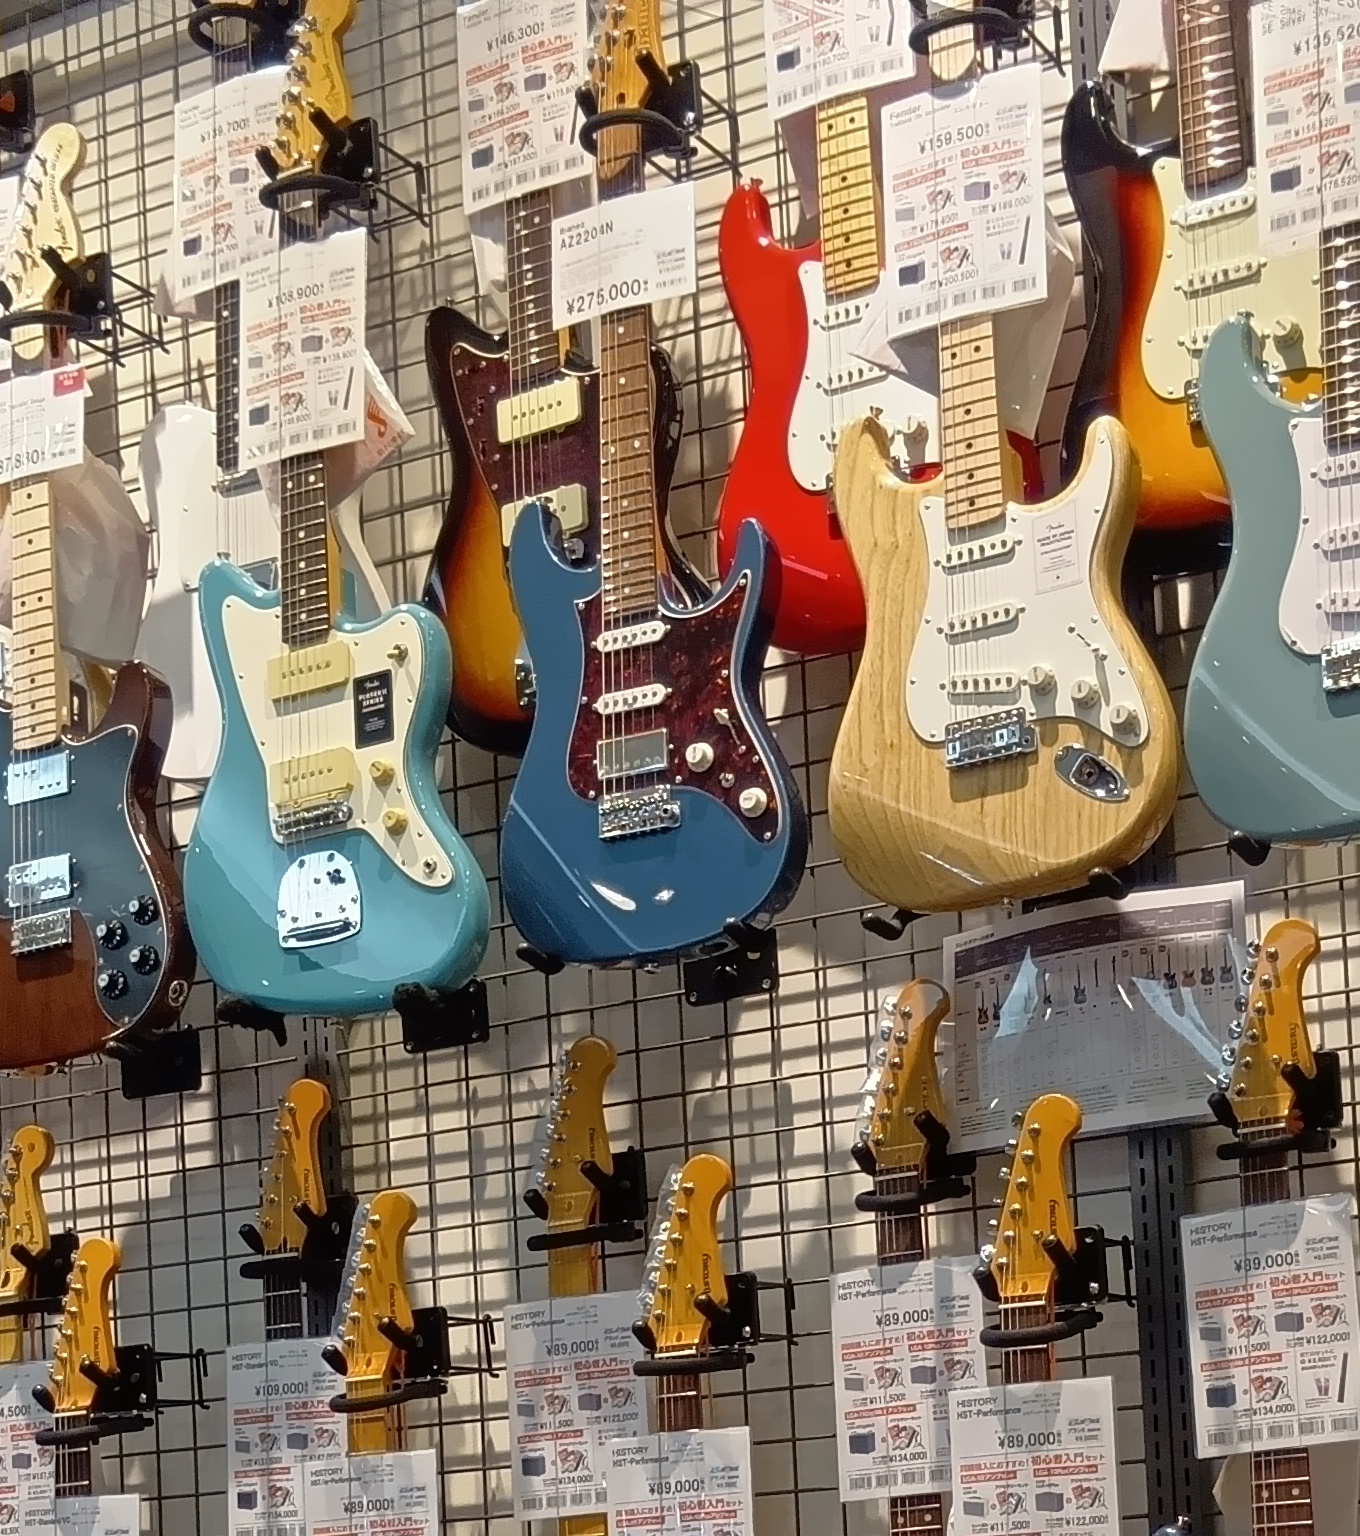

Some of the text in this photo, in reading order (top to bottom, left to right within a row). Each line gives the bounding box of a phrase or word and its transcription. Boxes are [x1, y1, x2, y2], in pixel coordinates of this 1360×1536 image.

[565, 279, 642, 315] ¥275,000
[1190, 1222, 1233, 1235] HISTORY
[876, 1308, 929, 1327] ¥89,000
[546, 1341, 595, 1356] ¥89,000
[957, 1397, 998, 1407] HISTORY
[998, 1433, 1056, 1449] ¥89,000
